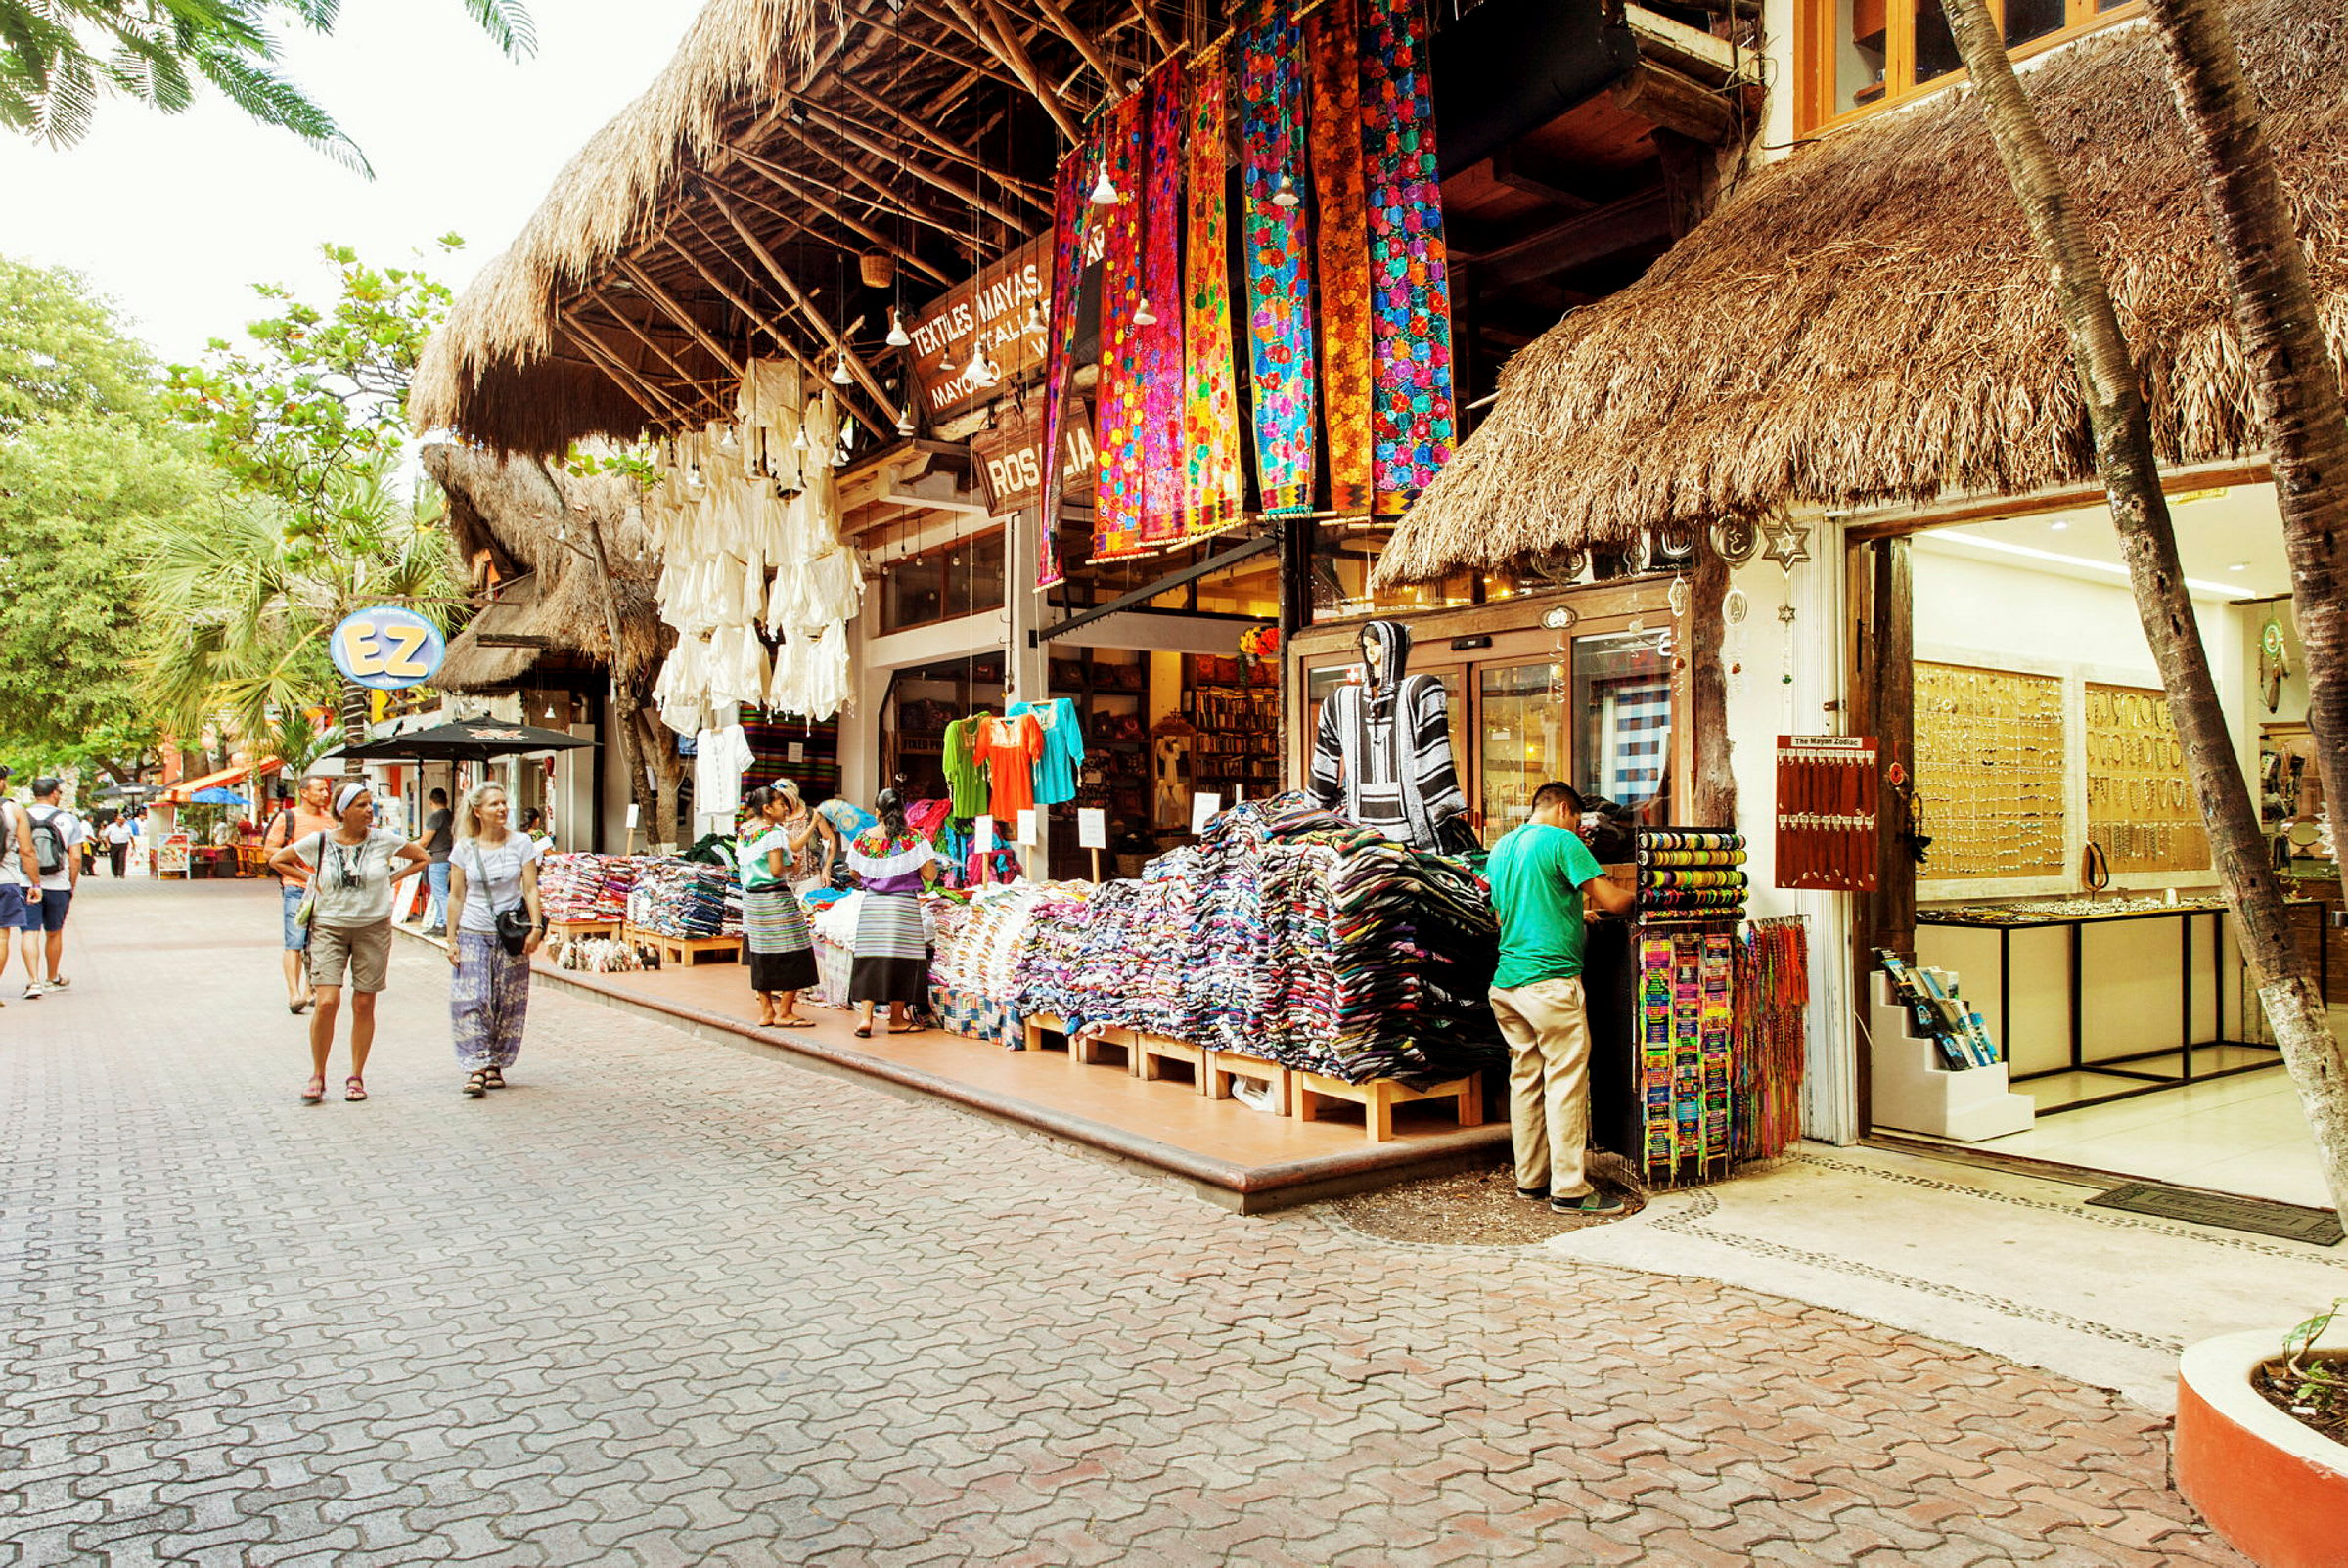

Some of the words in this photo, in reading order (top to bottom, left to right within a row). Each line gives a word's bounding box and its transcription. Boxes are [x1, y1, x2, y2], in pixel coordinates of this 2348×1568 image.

[910, 303, 974, 357] TEXTILES
[975, 264, 1043, 323] MAYAS
[931, 360, 1002, 409] MAYOO
[988, 427, 1095, 498] ROSIA
[342, 622, 429, 677] EZ
[1810, 738, 1832, 746] Mayan
[1834, 738, 1858, 746] Zodiac
